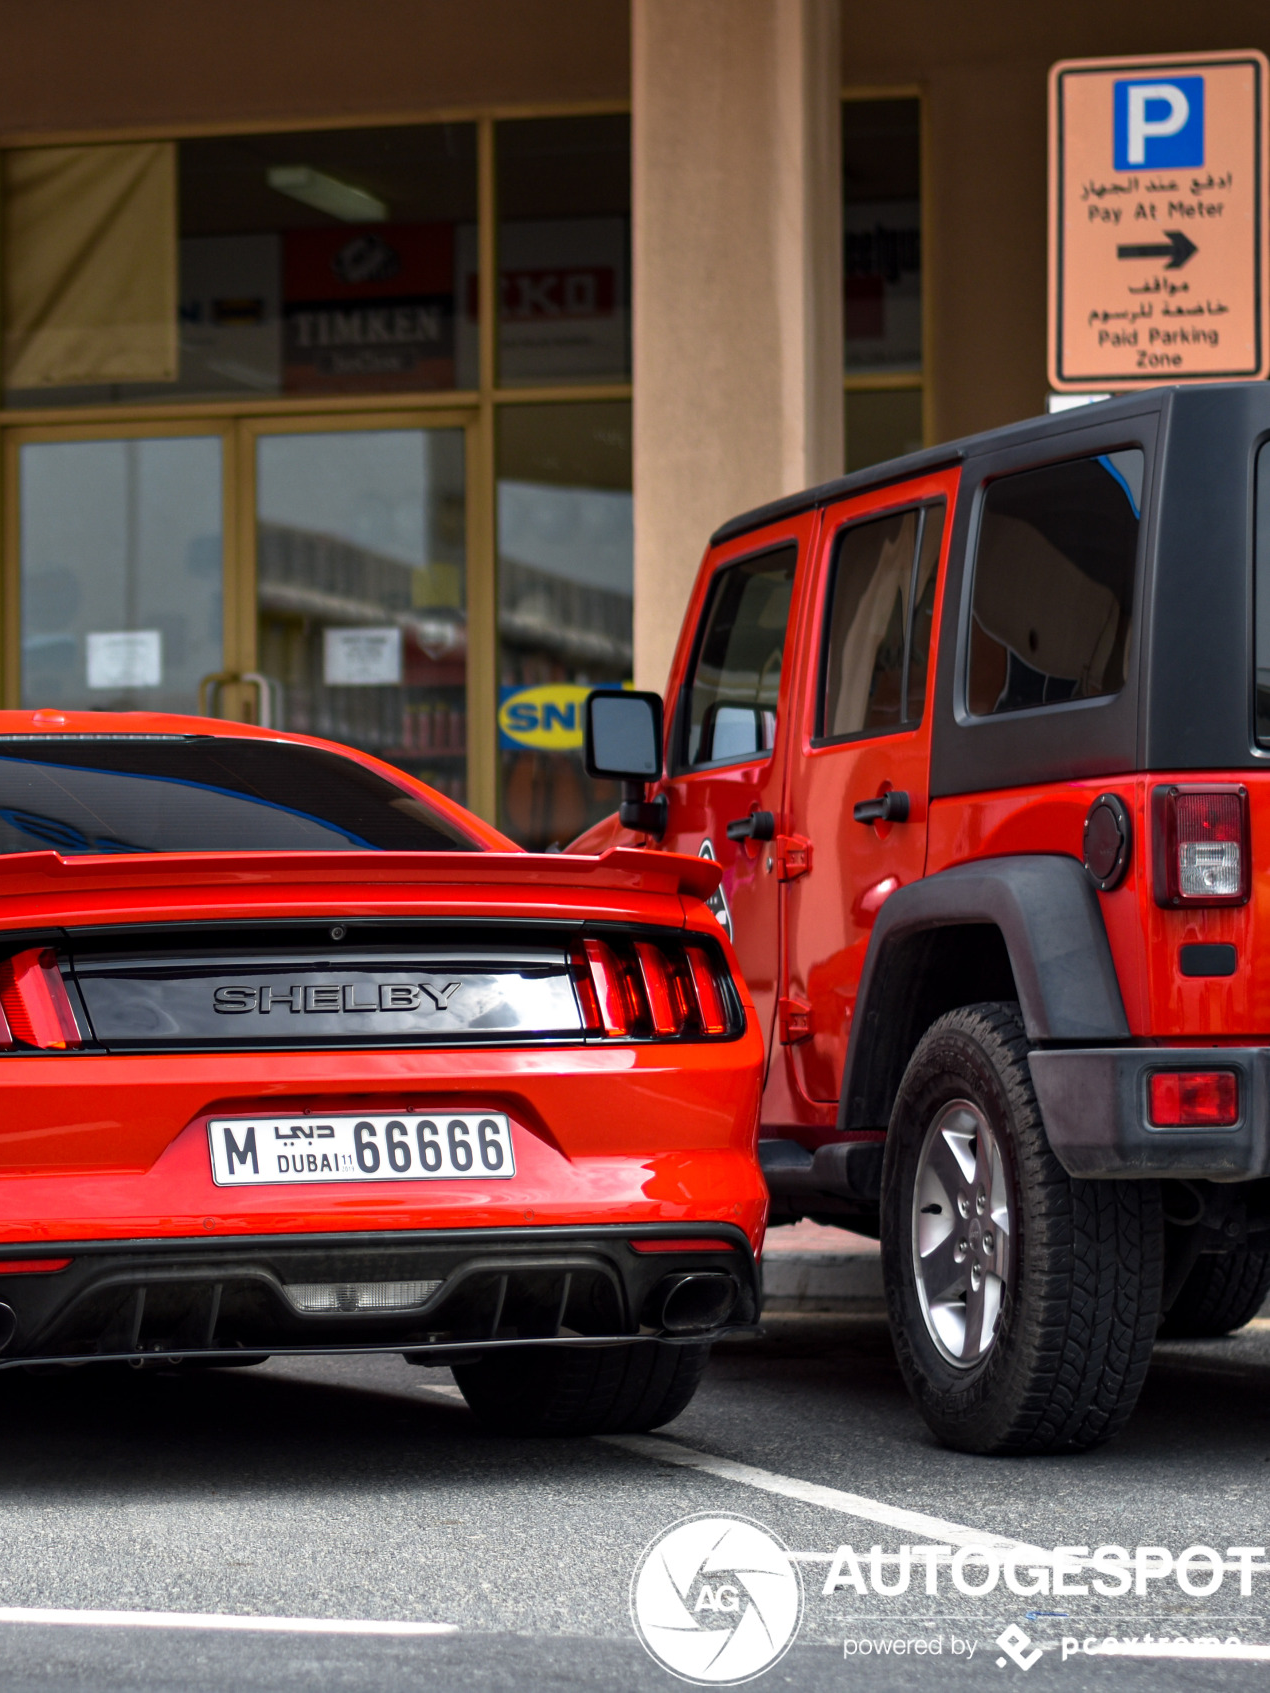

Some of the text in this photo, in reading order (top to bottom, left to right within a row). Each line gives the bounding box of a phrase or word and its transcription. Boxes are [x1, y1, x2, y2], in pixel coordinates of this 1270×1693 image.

[1127, 83, 1190, 165] P
[1145, 176, 1179, 193] عند
[1088, 200, 1224, 226] Pay At Meter
[1128, 275, 1189, 296] مواقف
[295, 304, 442, 347] TIMKEN
[1089, 300, 1229, 327] خاضعة للرسوم
[1099, 325, 1219, 347] Paid Parking
[1137, 350, 1183, 368] Zone
[506, 702, 583, 732] SN
[213, 982, 462, 1014] SHELBY
[223, 1119, 504, 1175] M 66666
[274, 1125, 336, 1147] دبي
[277, 1153, 340, 1173] DUBAI
